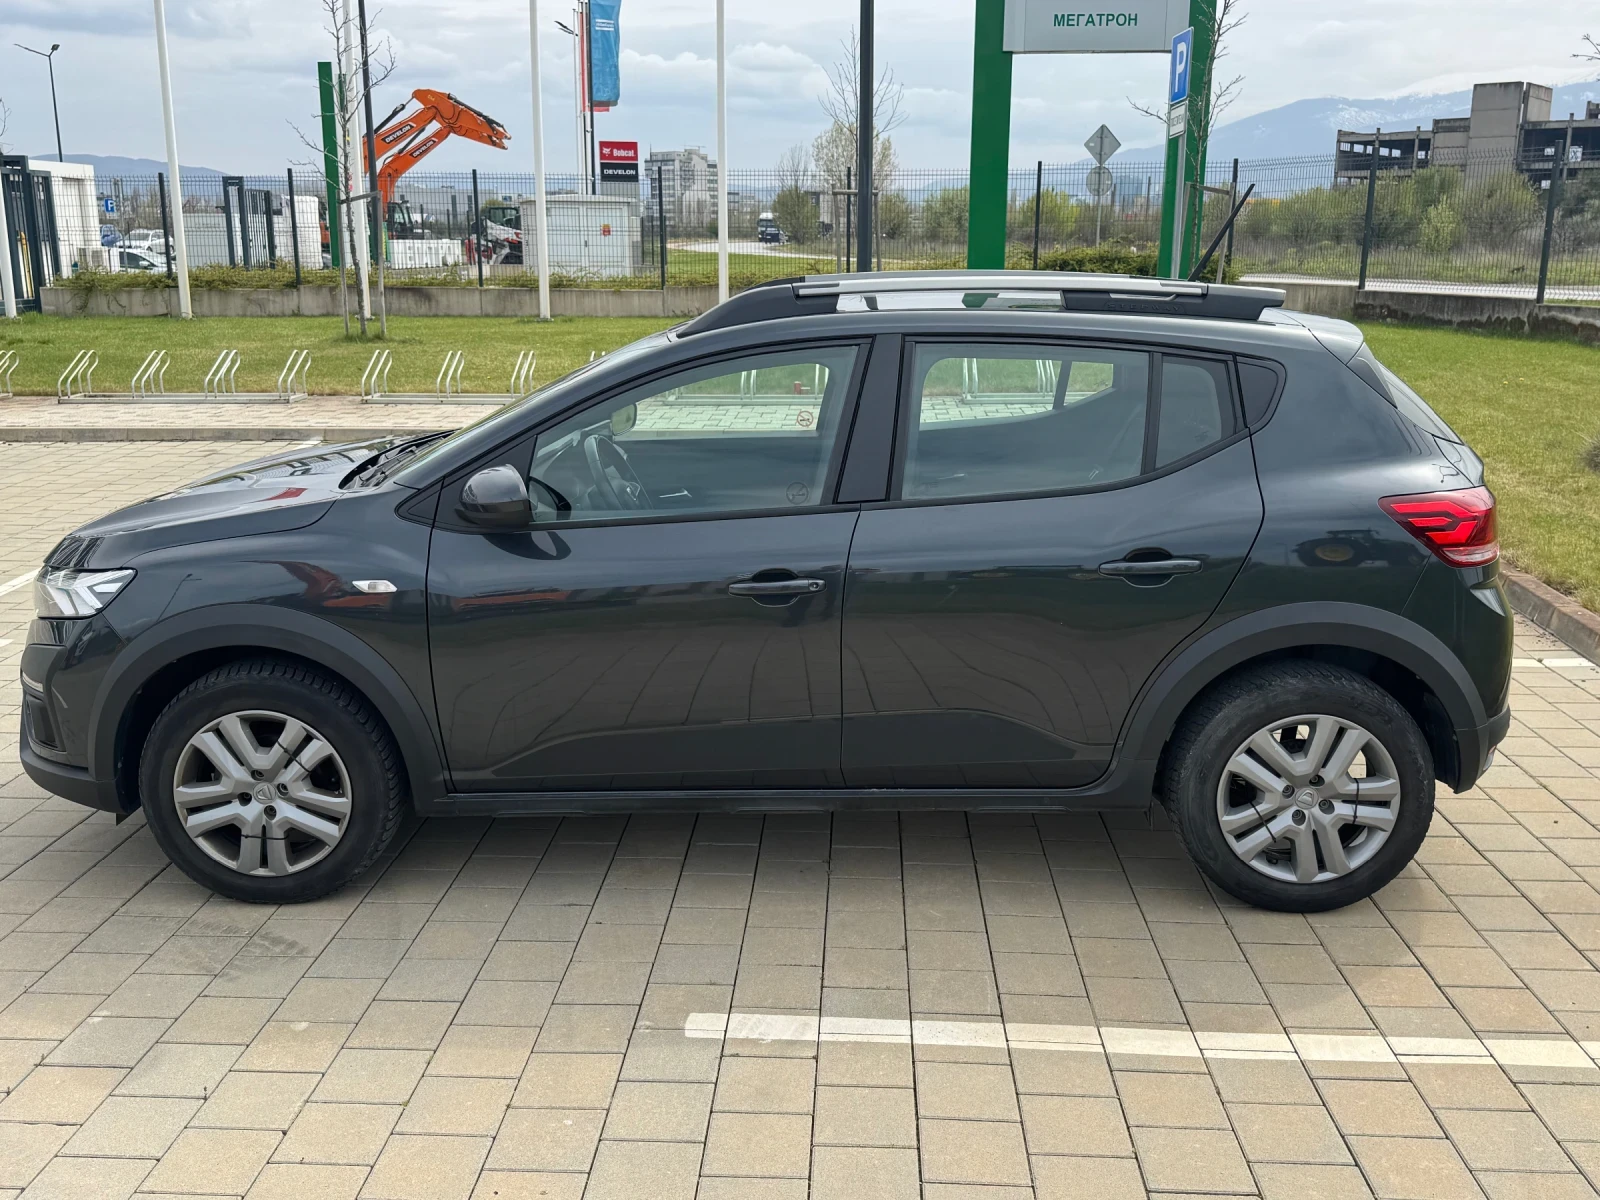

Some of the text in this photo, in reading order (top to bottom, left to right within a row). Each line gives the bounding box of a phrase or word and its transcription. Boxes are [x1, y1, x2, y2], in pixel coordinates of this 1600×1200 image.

[1053, 13, 1138, 27] МЕГАТРОН
[1174, 41, 1187, 93] P
[385, 124, 412, 143] DEVELON
[412, 140, 434, 158] DEVELON
[613, 148, 635, 157] Bobcat
